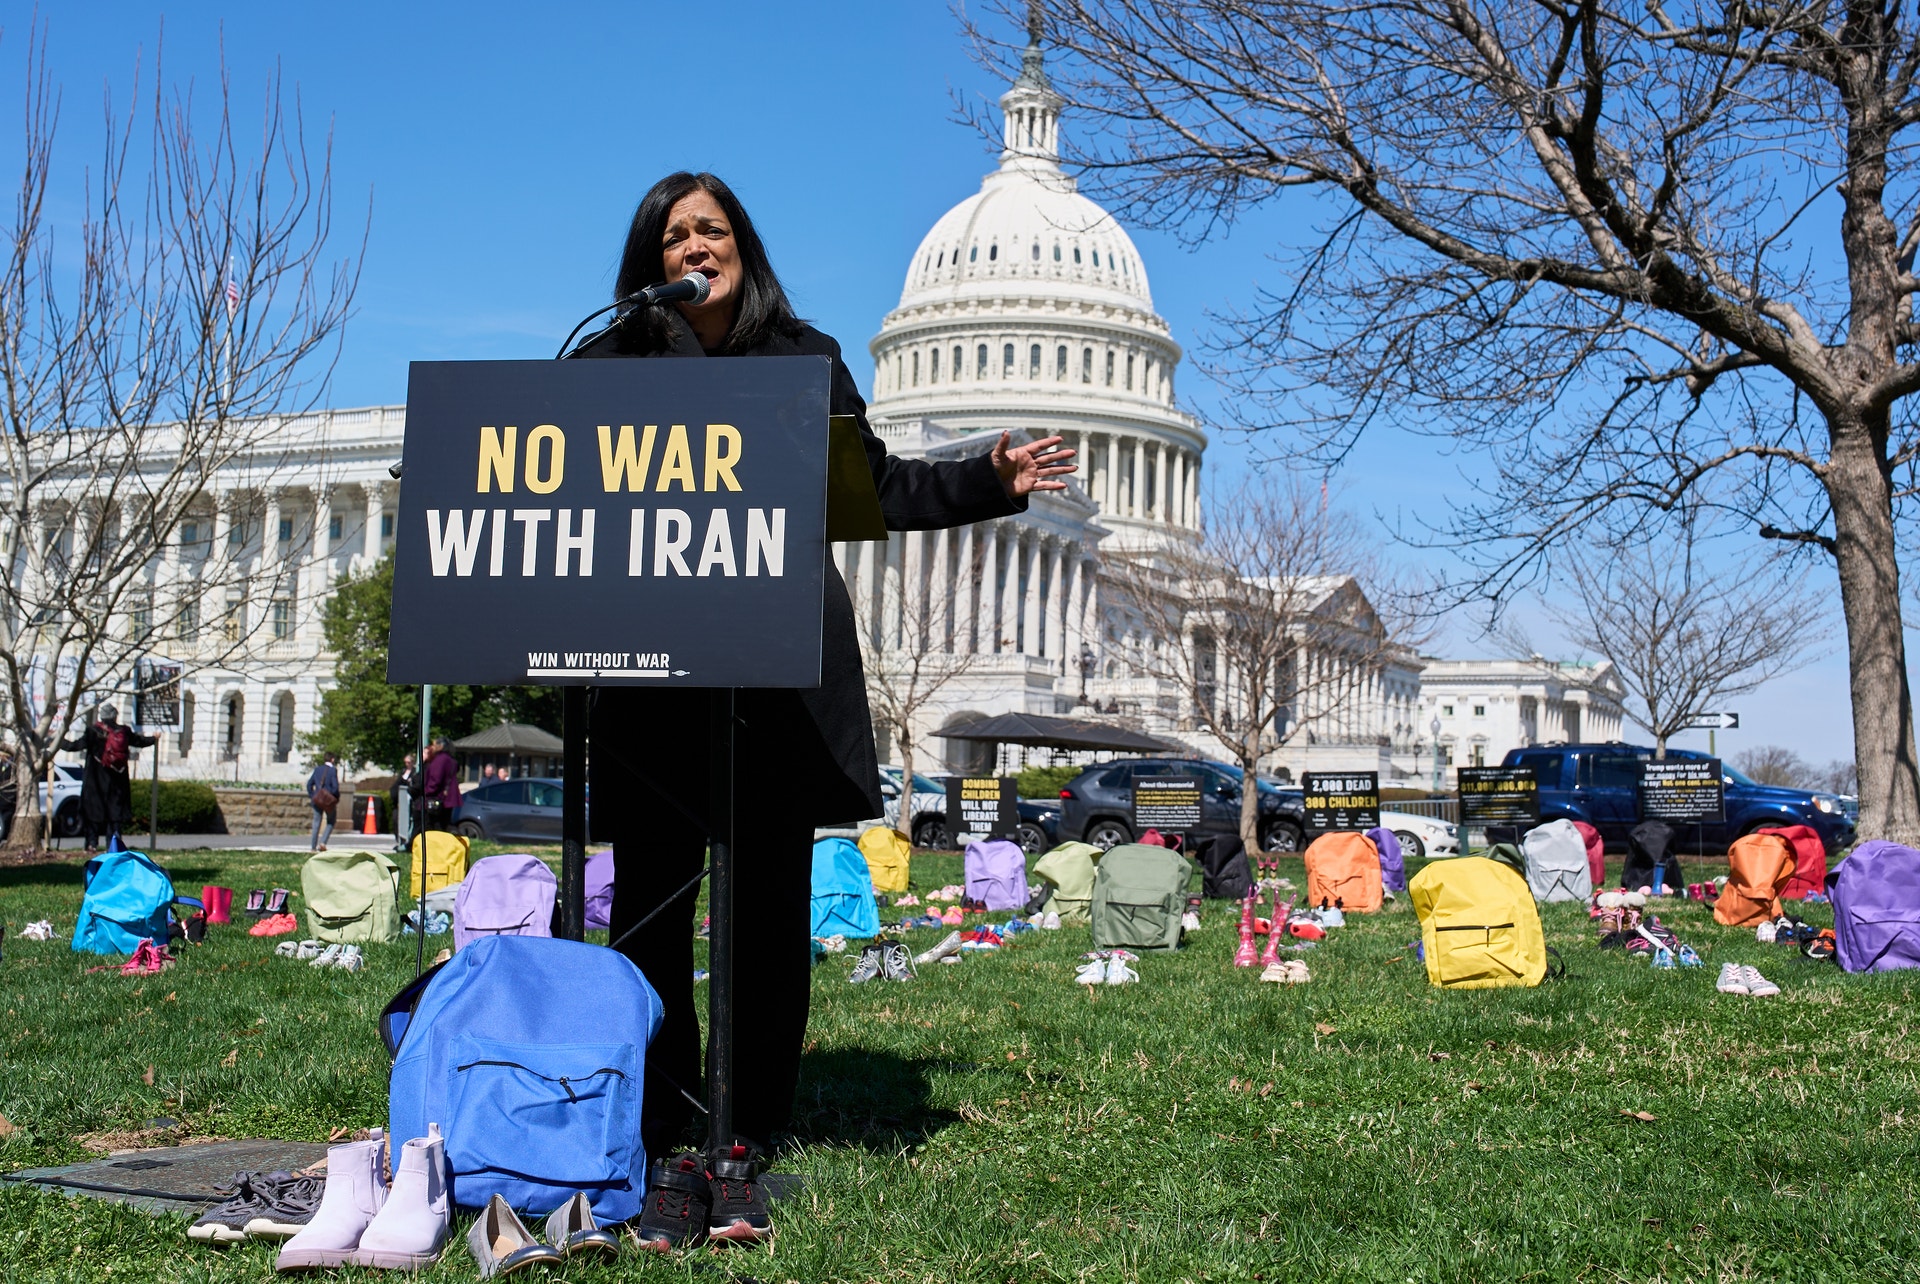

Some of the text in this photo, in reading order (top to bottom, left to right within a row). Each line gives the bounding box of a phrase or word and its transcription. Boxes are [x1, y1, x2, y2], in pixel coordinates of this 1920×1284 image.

[476, 424, 743, 494] NO WAR
[426, 508, 786, 577] WITH IRAN
[528, 652, 670, 668] WIN WITHOUT WAR
[1645, 763, 1665, 772] Trump
[1665, 763, 1684, 771] wants
[962, 778, 1000, 789] BOMBING
[1312, 779, 1372, 792] 2,000 DEAD
[961, 789, 1001, 800] CHILDREN
[960, 800, 999, 811] WILL NOT
[1305, 796, 1377, 809] 300 CHILDREN
[962, 811, 999, 821] LIBERATE
[969, 822, 992, 832] THEM
